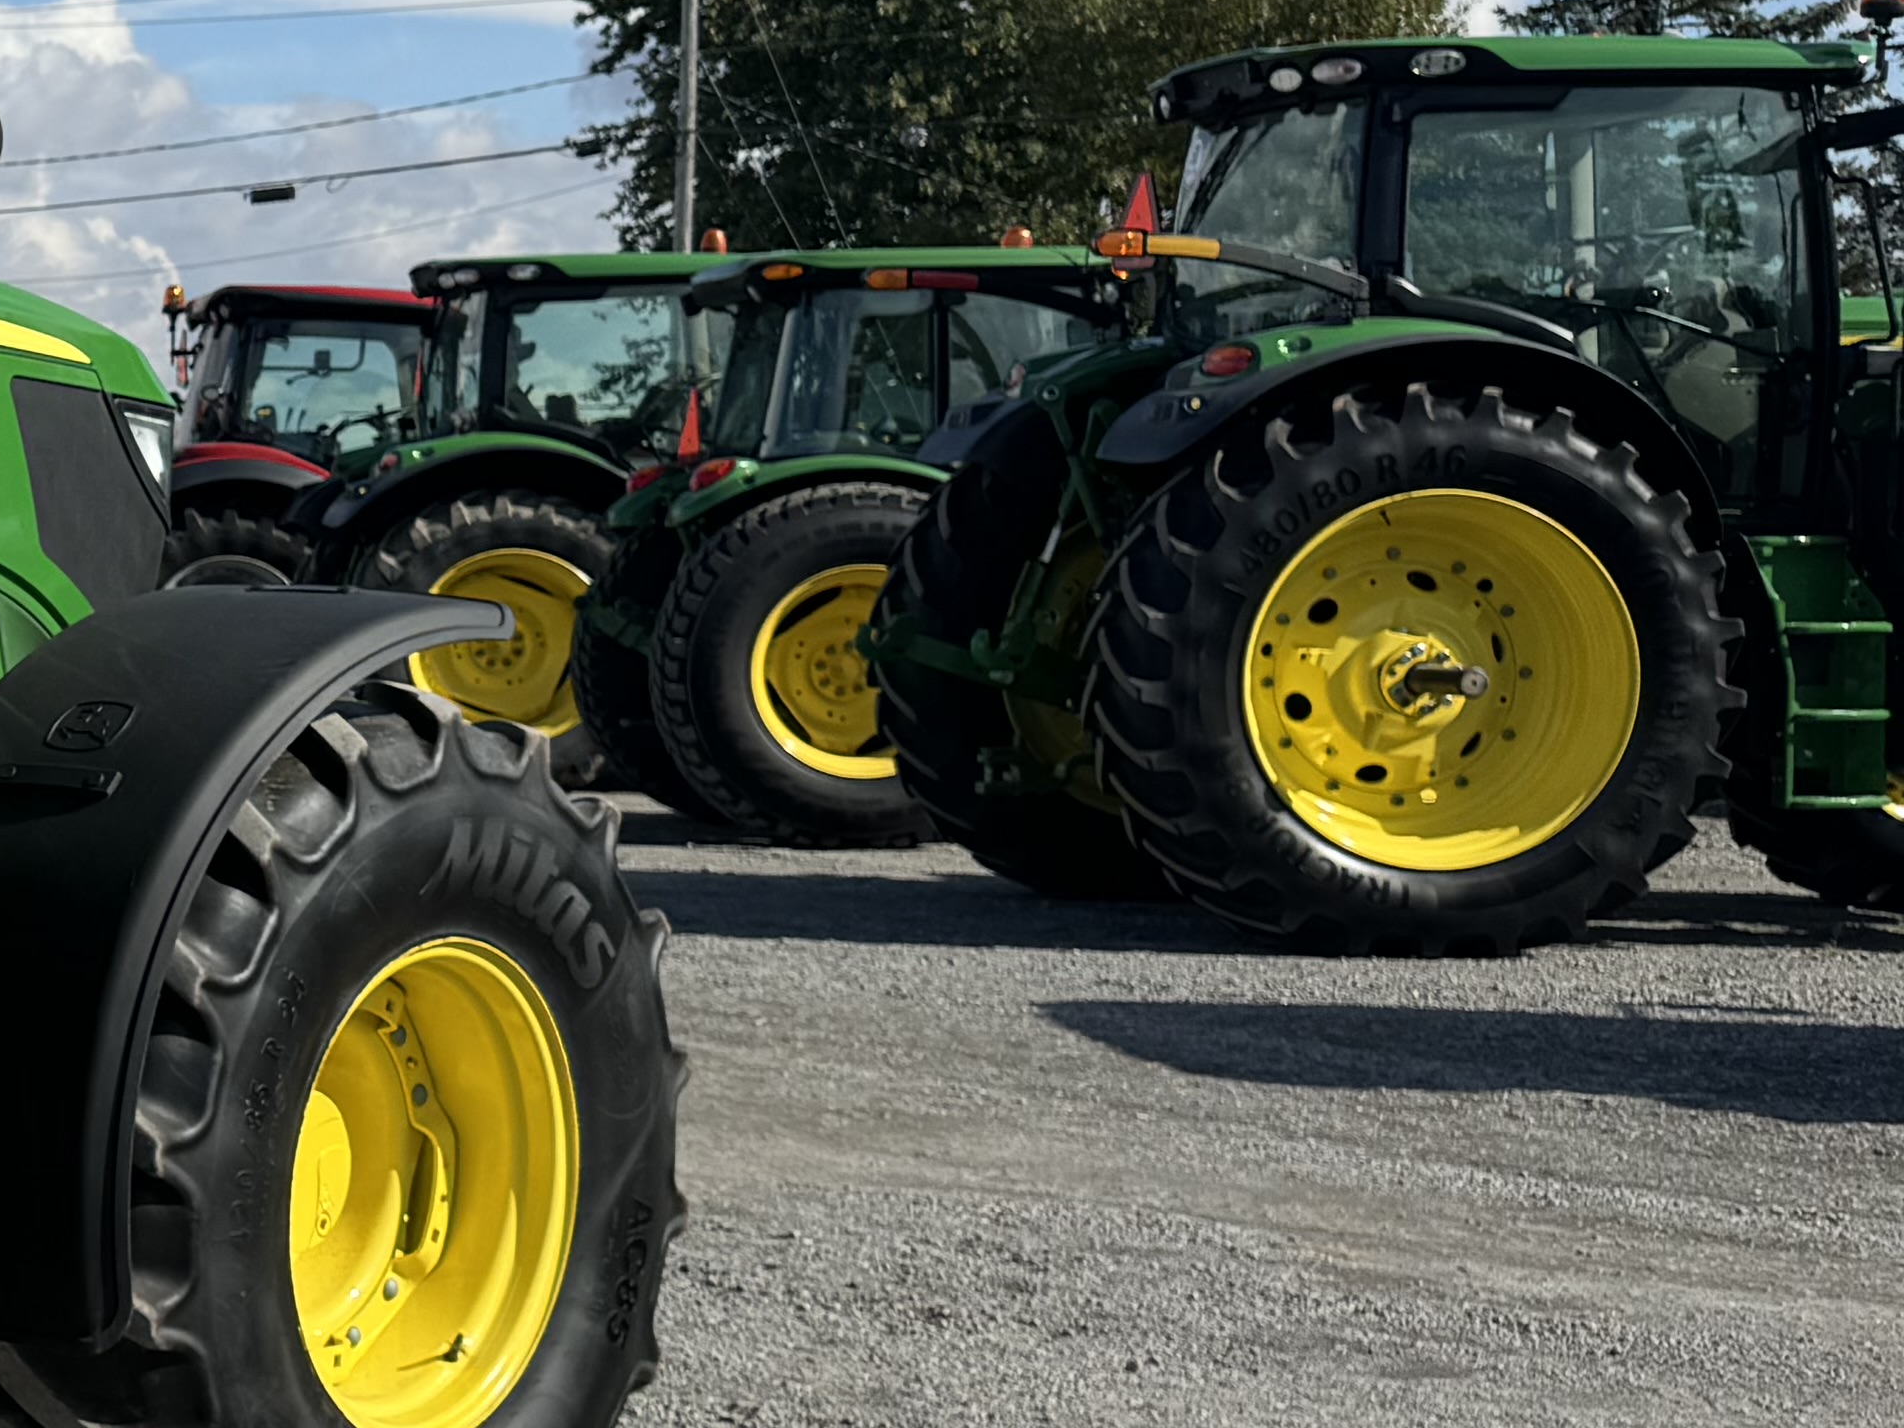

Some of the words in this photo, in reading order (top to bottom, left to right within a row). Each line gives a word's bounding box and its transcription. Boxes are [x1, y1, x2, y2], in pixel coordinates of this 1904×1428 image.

[1240, 466, 1362, 576] 480/80
[1374, 452, 1402, 486] R
[1413, 444, 1468, 477] 46
[418, 815, 622, 990] Mitas
[602, 1194, 658, 1352] AC85
